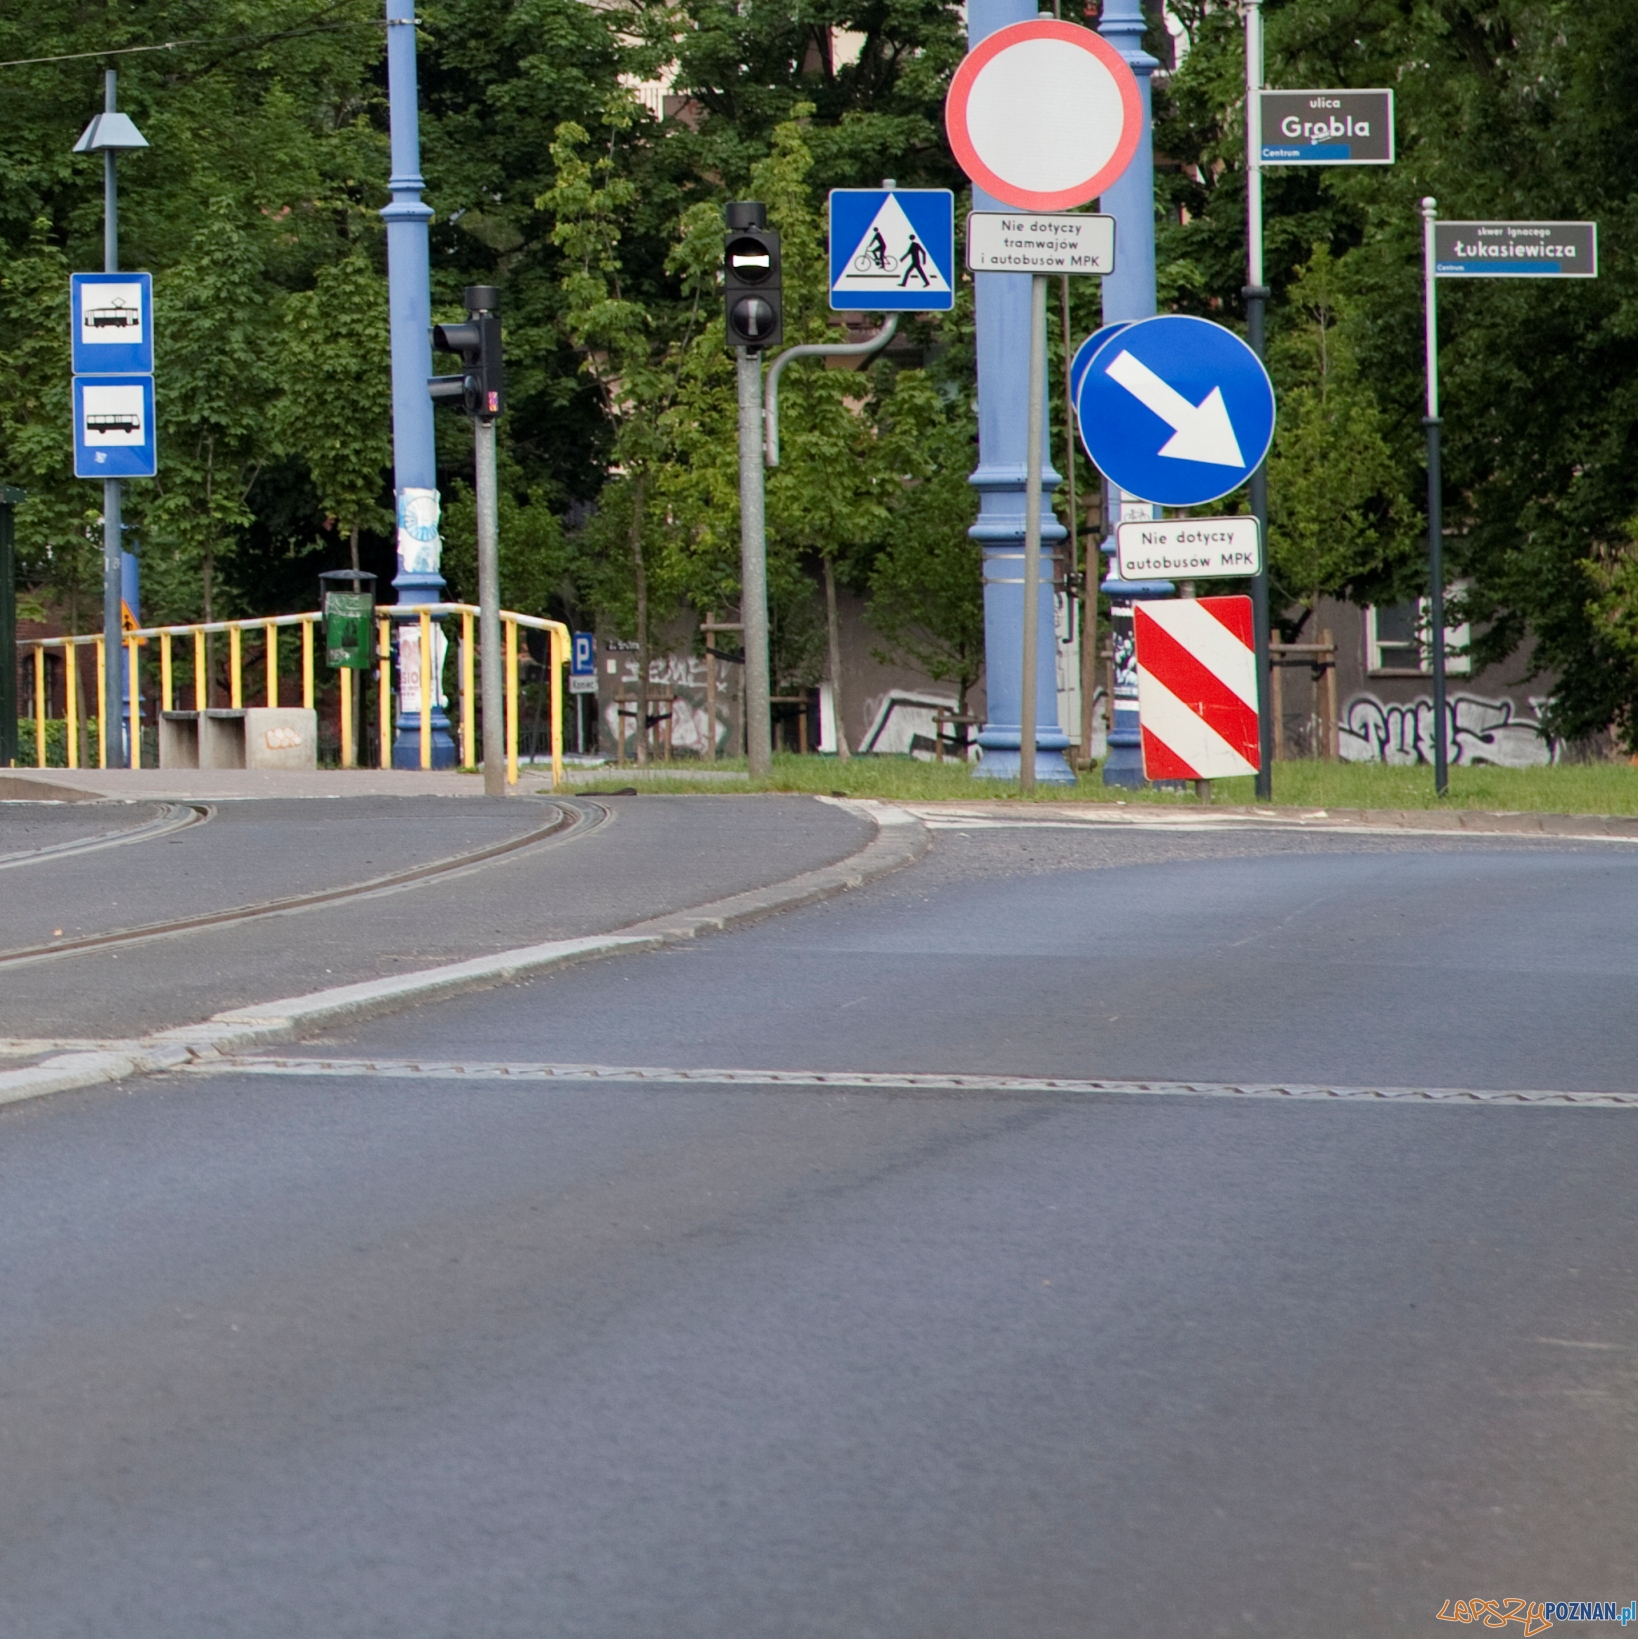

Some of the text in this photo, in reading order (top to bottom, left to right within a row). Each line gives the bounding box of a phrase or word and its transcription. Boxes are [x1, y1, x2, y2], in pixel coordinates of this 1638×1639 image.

[1309, 97, 1341, 108] ulica
[1281, 115, 1370, 137] Grobla
[1262, 148, 1300, 157] Centrum
[1001, 220, 1082, 236] Nie dotyczy
[1477, 227, 1551, 238] skwer Ignacego
[1004, 238, 1078, 251] tramwajów
[1454, 240, 1576, 257] Łukasiewicza
[981, 253, 1100, 267] i autobusów MPK
[1141, 531, 1234, 546] Nie dotyczy
[1126, 552, 1253, 570] autobusów MPK
[576, 638, 590, 670] P
